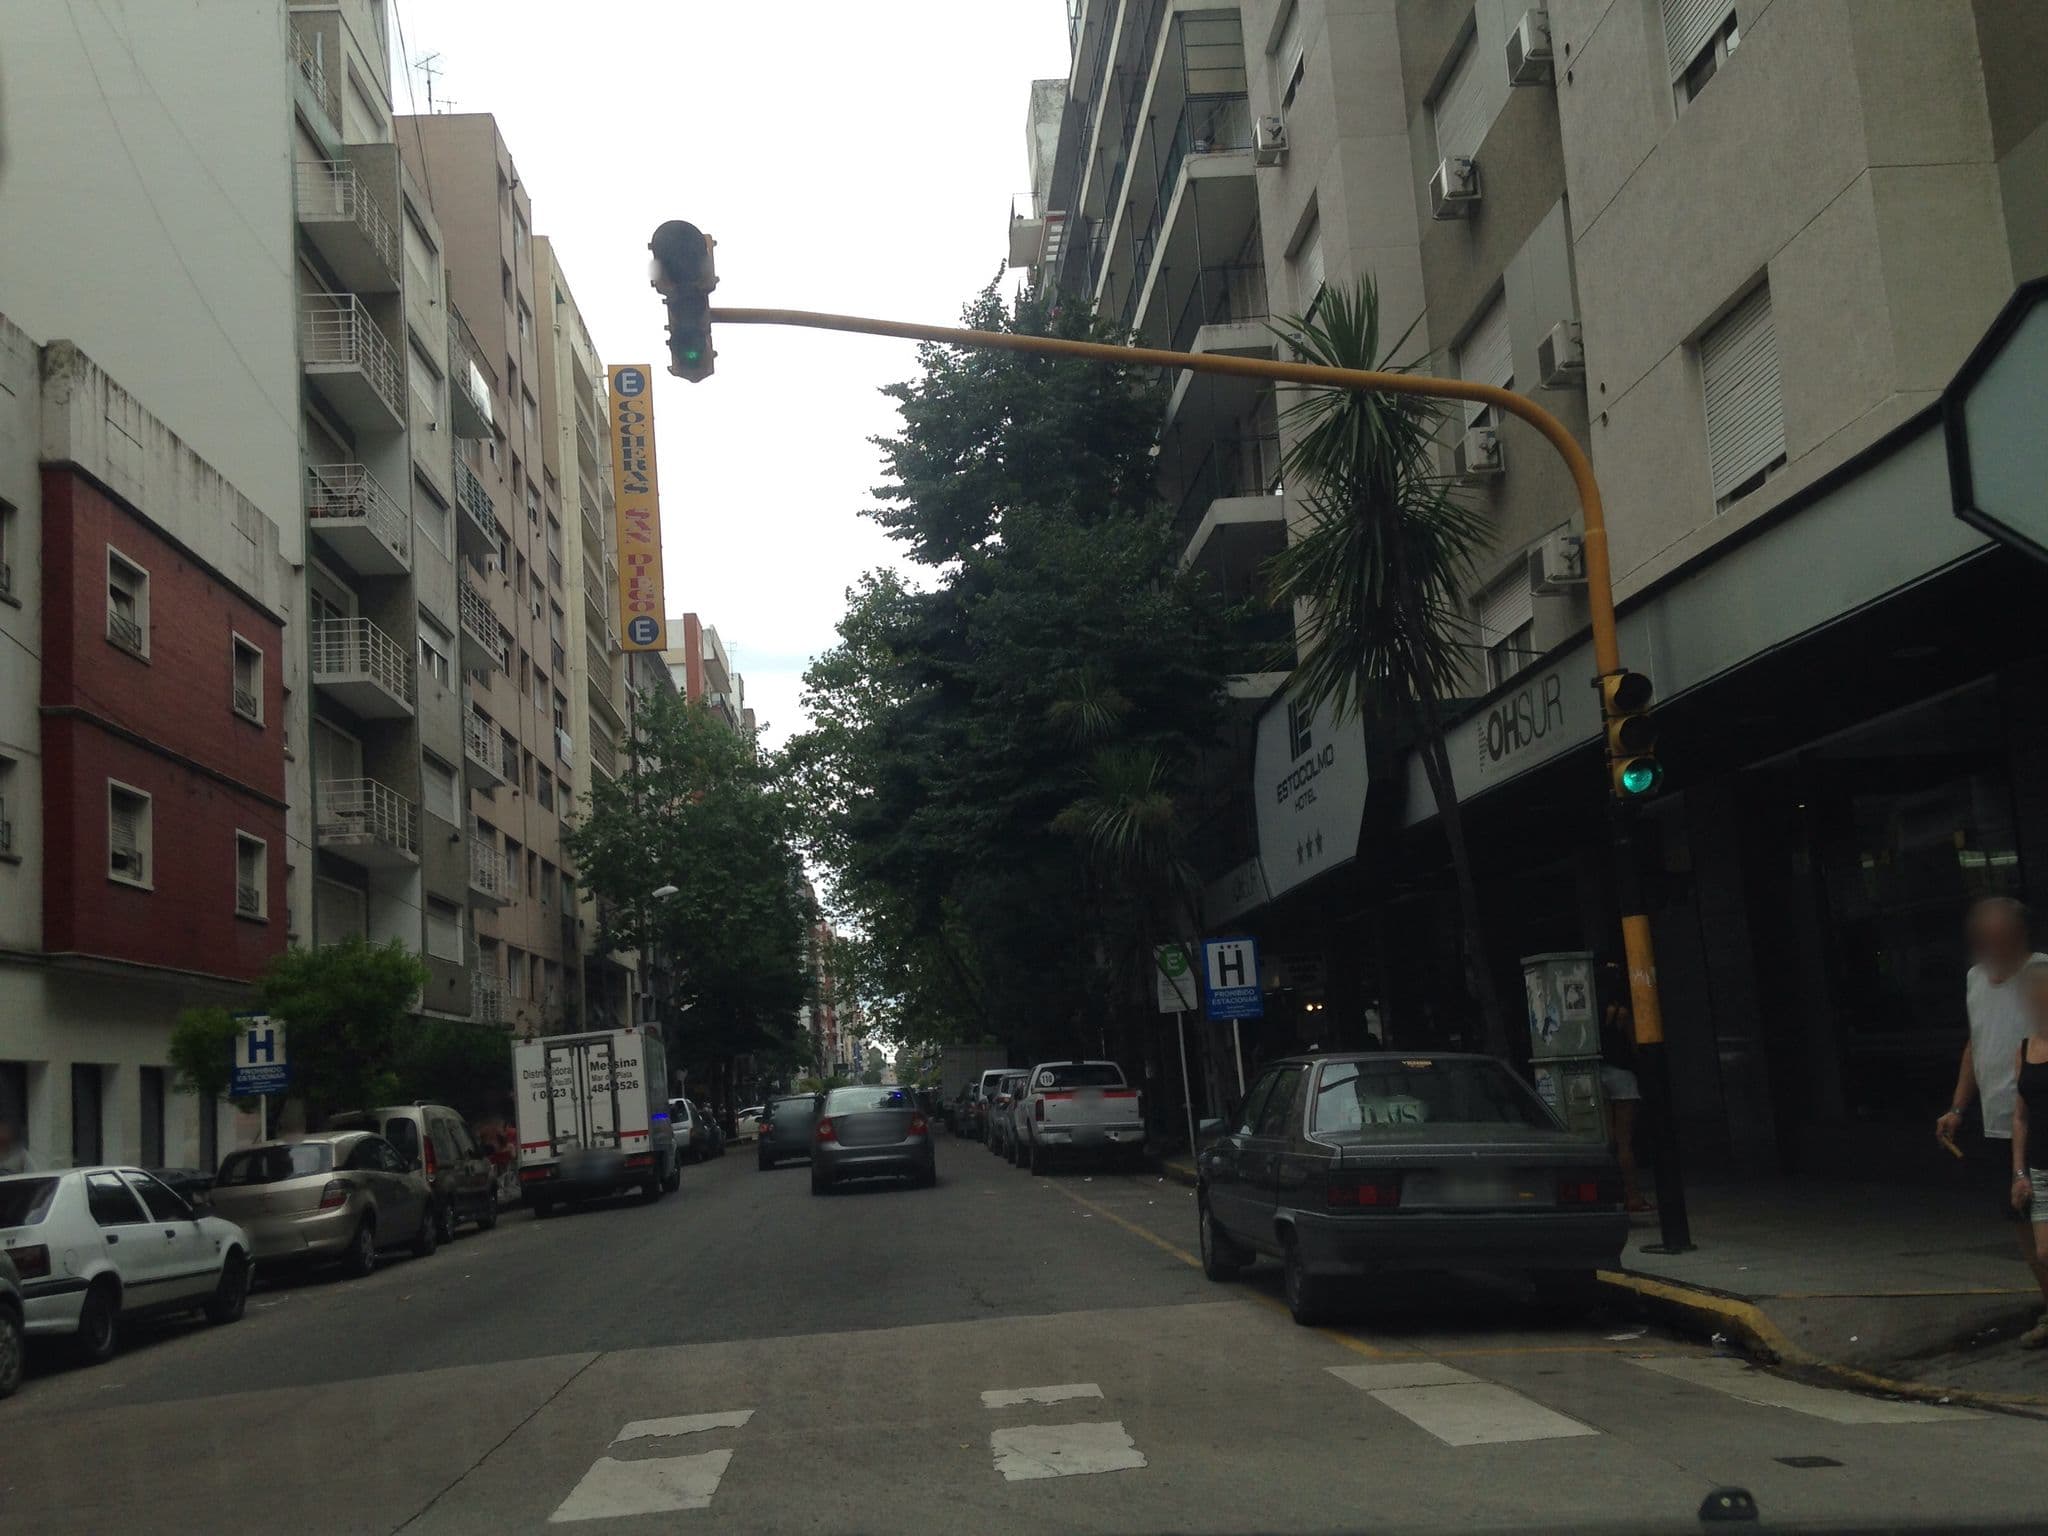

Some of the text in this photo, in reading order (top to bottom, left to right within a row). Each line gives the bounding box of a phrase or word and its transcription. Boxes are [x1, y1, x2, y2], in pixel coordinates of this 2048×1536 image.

[621, 373, 638, 393] E
[618, 400, 649, 495] COCHERAS
[635, 620, 652, 642] E
[1487, 673, 1564, 762] OHSUR
[1277, 743, 1335, 805] ESTOCOLMO
[1294, 788, 1318, 814] HOTEL
[1218, 949, 1246, 987] H
[1212, 996, 1258, 1006] ESTACIONAR
[1214, 988, 1255, 998] PROHIBIDO
[248, 1030, 274, 1063] H
